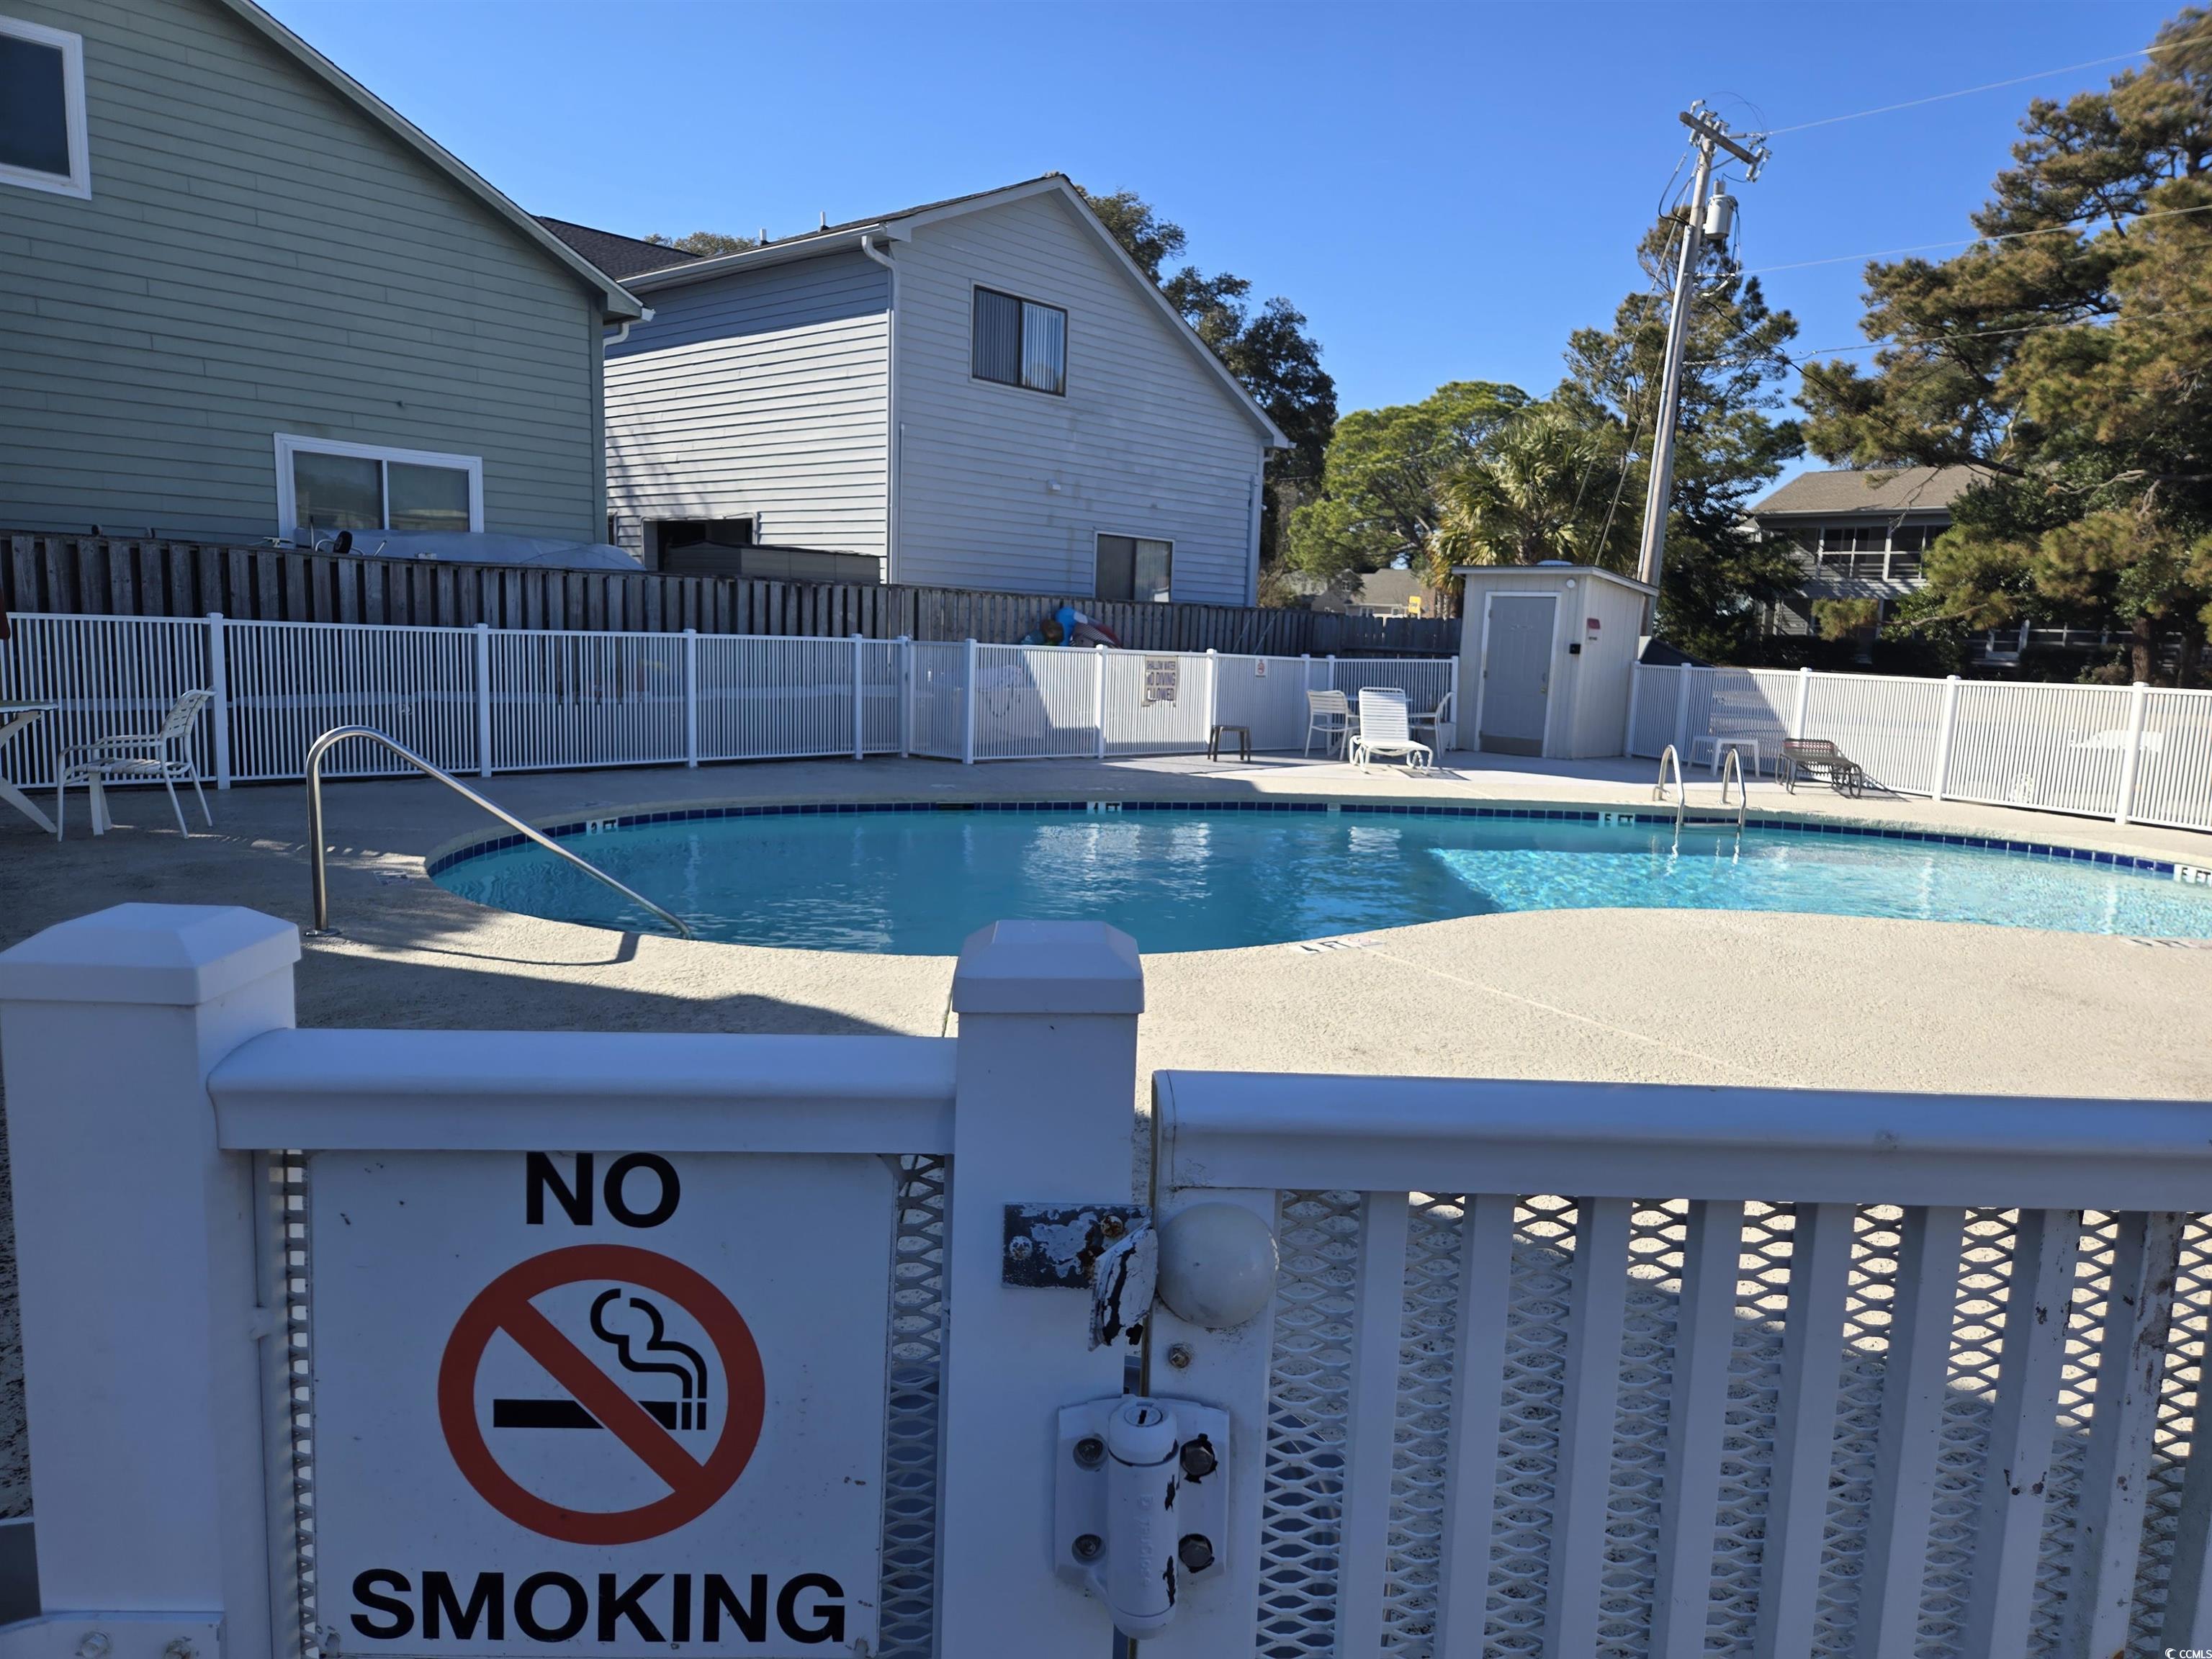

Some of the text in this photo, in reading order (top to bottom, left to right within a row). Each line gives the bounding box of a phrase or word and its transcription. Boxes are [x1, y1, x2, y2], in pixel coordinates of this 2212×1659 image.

[1156, 672, 1176, 686] DIVING
[2195, 869, 2211, 881] FT
[526, 1151, 680, 1228] NO
[350, 1568, 846, 1645] SMOKING
